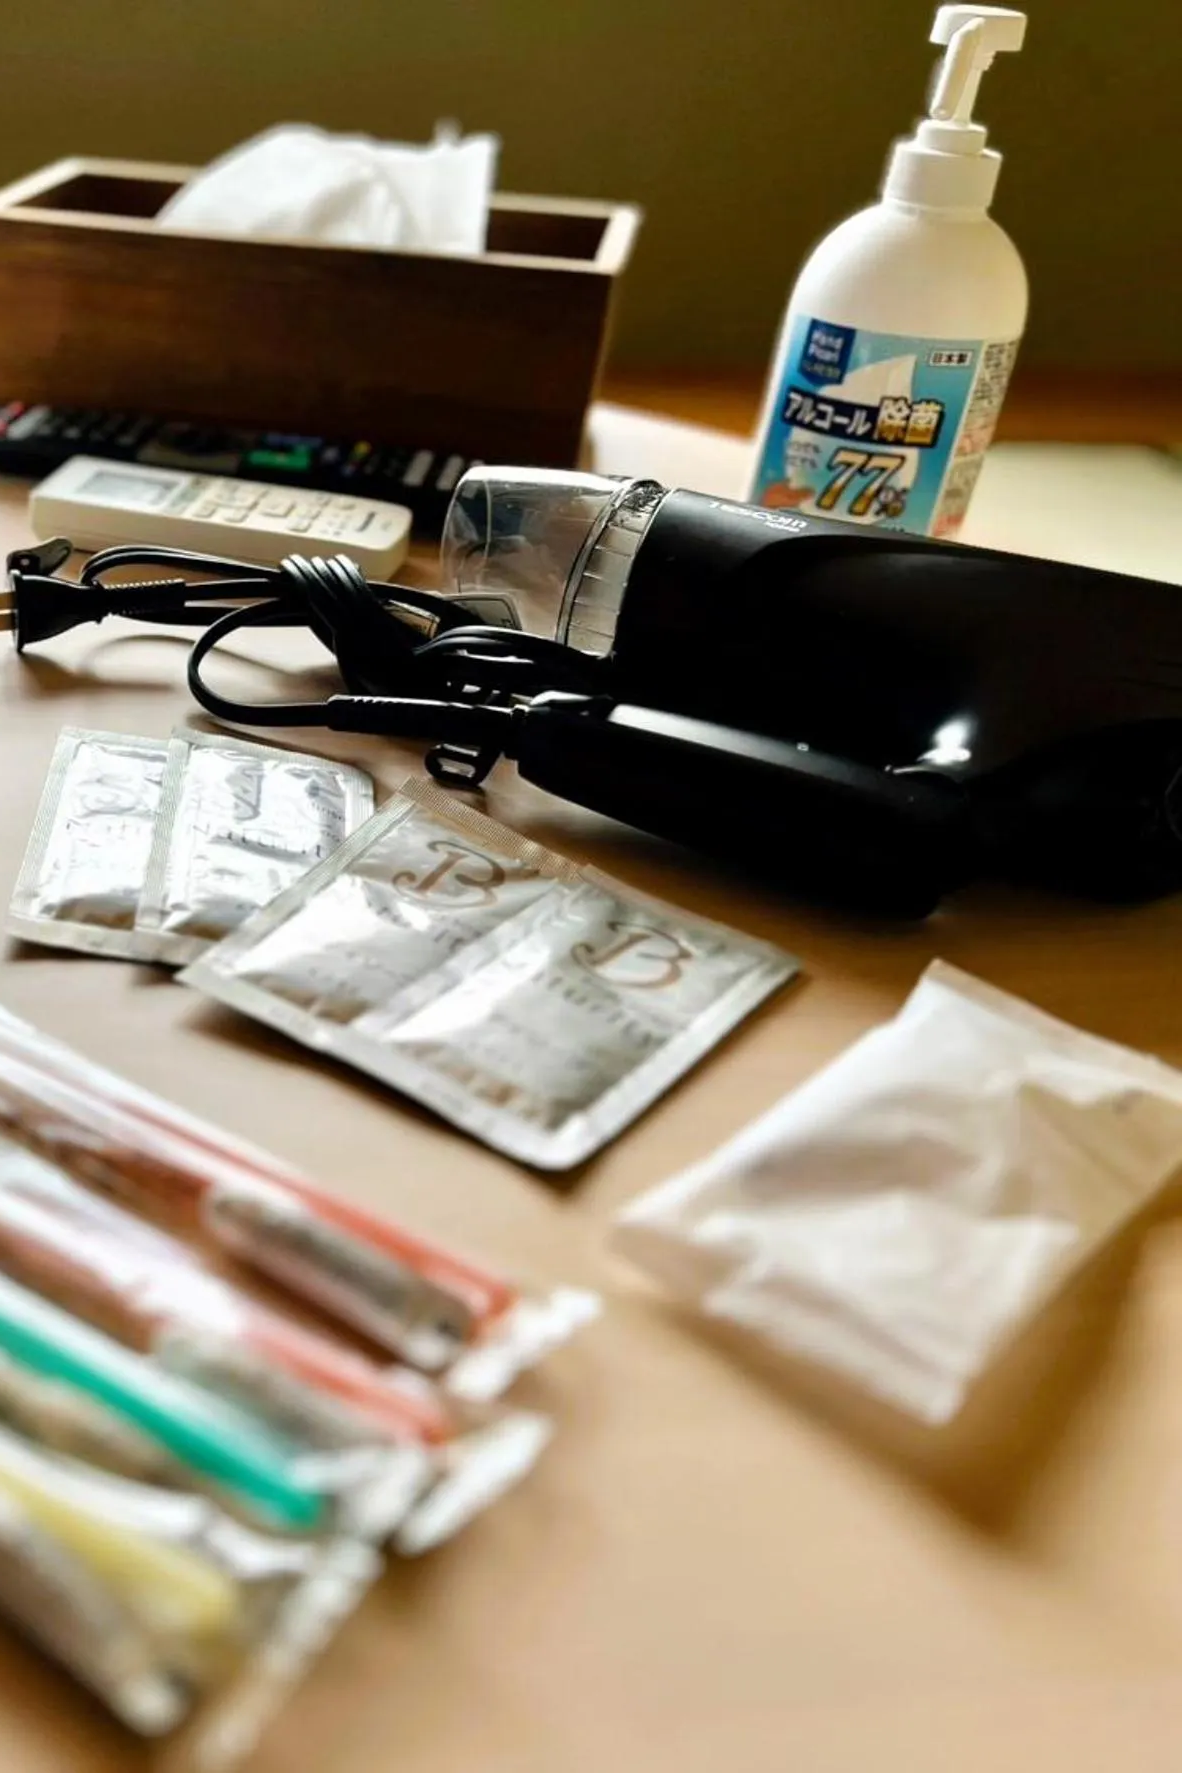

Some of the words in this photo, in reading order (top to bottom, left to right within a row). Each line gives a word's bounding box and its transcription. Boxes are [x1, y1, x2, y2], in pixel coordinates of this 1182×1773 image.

[931, 352, 969, 365] 日本製
[783, 391, 943, 444] アルコール除菌
